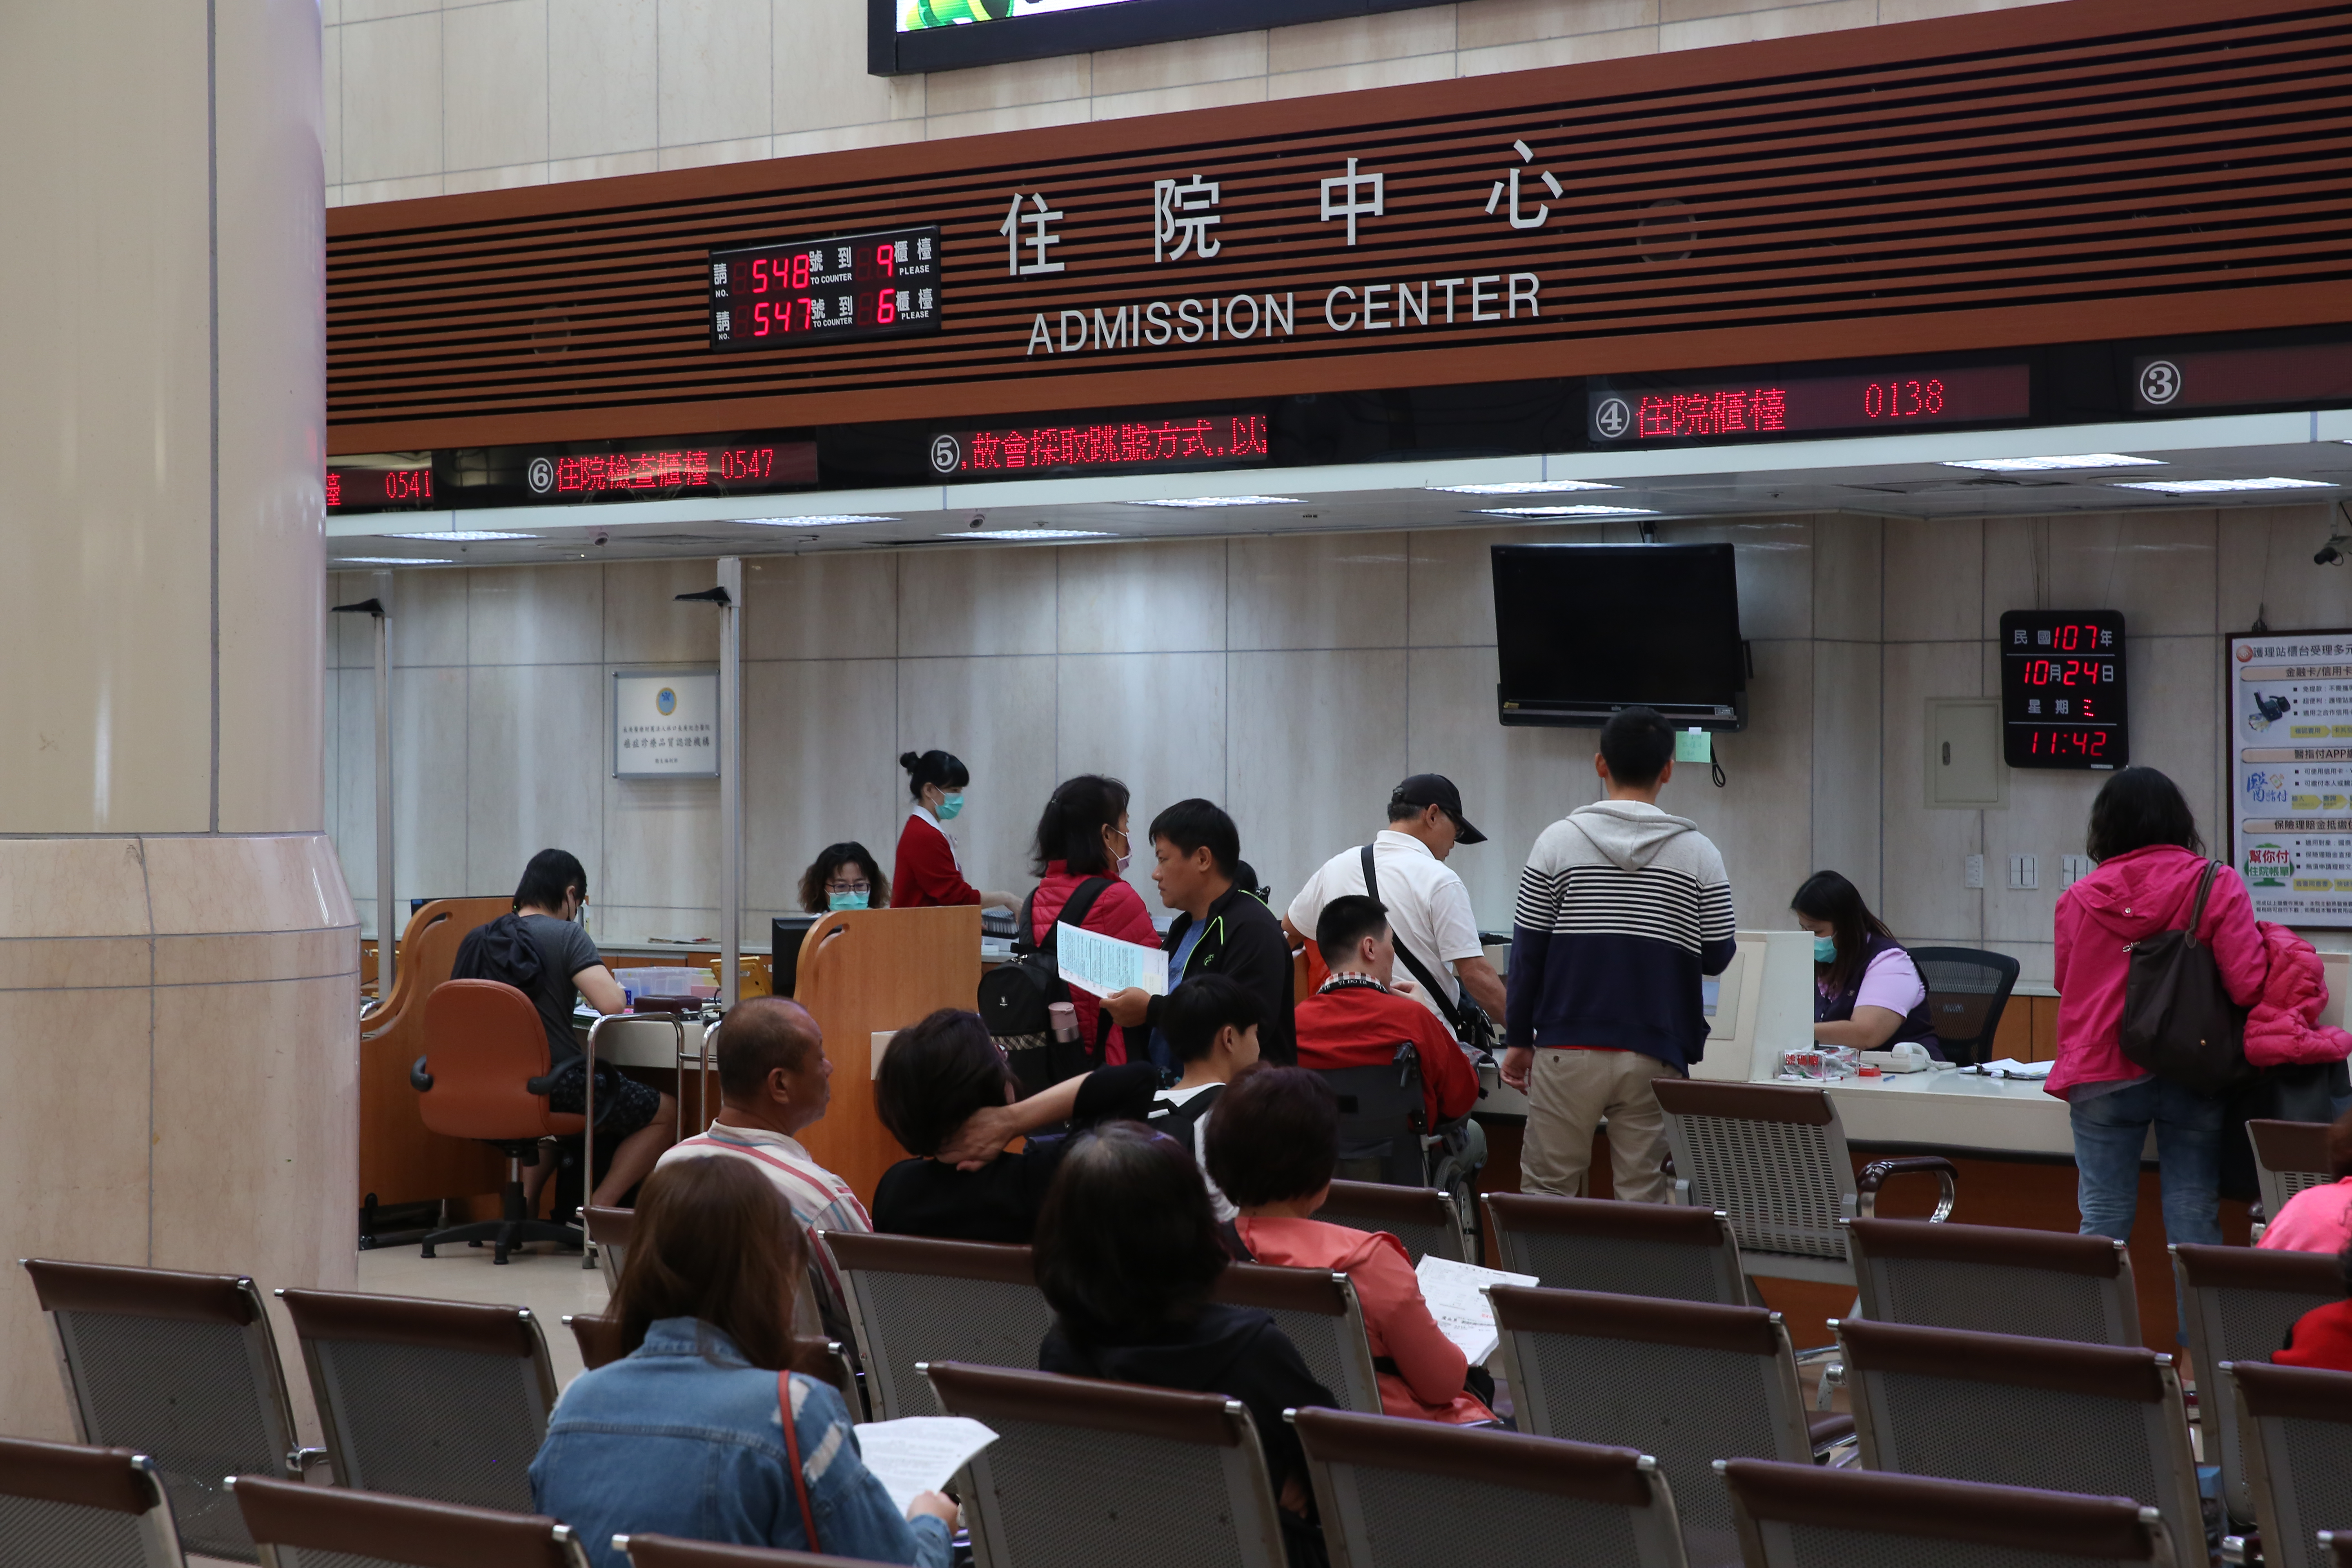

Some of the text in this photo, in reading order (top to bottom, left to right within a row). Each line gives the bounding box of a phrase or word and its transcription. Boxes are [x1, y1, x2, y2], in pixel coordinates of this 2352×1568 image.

[1000, 139, 1563, 276] 住院中心
[714, 263, 727, 285] 請
[753, 254, 809, 293] 548
[877, 245, 893, 277] 9
[821, 273, 852, 283] COUNTER
[899, 265, 930, 276] PLEASE
[716, 311, 730, 332] 請
[754, 298, 811, 336] 547
[878, 288, 895, 323] 6
[822, 317, 852, 326] COUNTER
[901, 311, 929, 319] PLEASE
[1027, 272, 1540, 355] ADMISSION CENTER
[1635, 388, 1786, 438] 住院櫃檯
[1864, 379, 1943, 417] 0138
[721, 449, 773, 479] 0547
[386, 470, 431, 498] 0541
[2032, 731, 2107, 757] 11:42
[2249, 849, 2289, 864] 幫你付
[2249, 866, 2290, 878] 住院帳單
